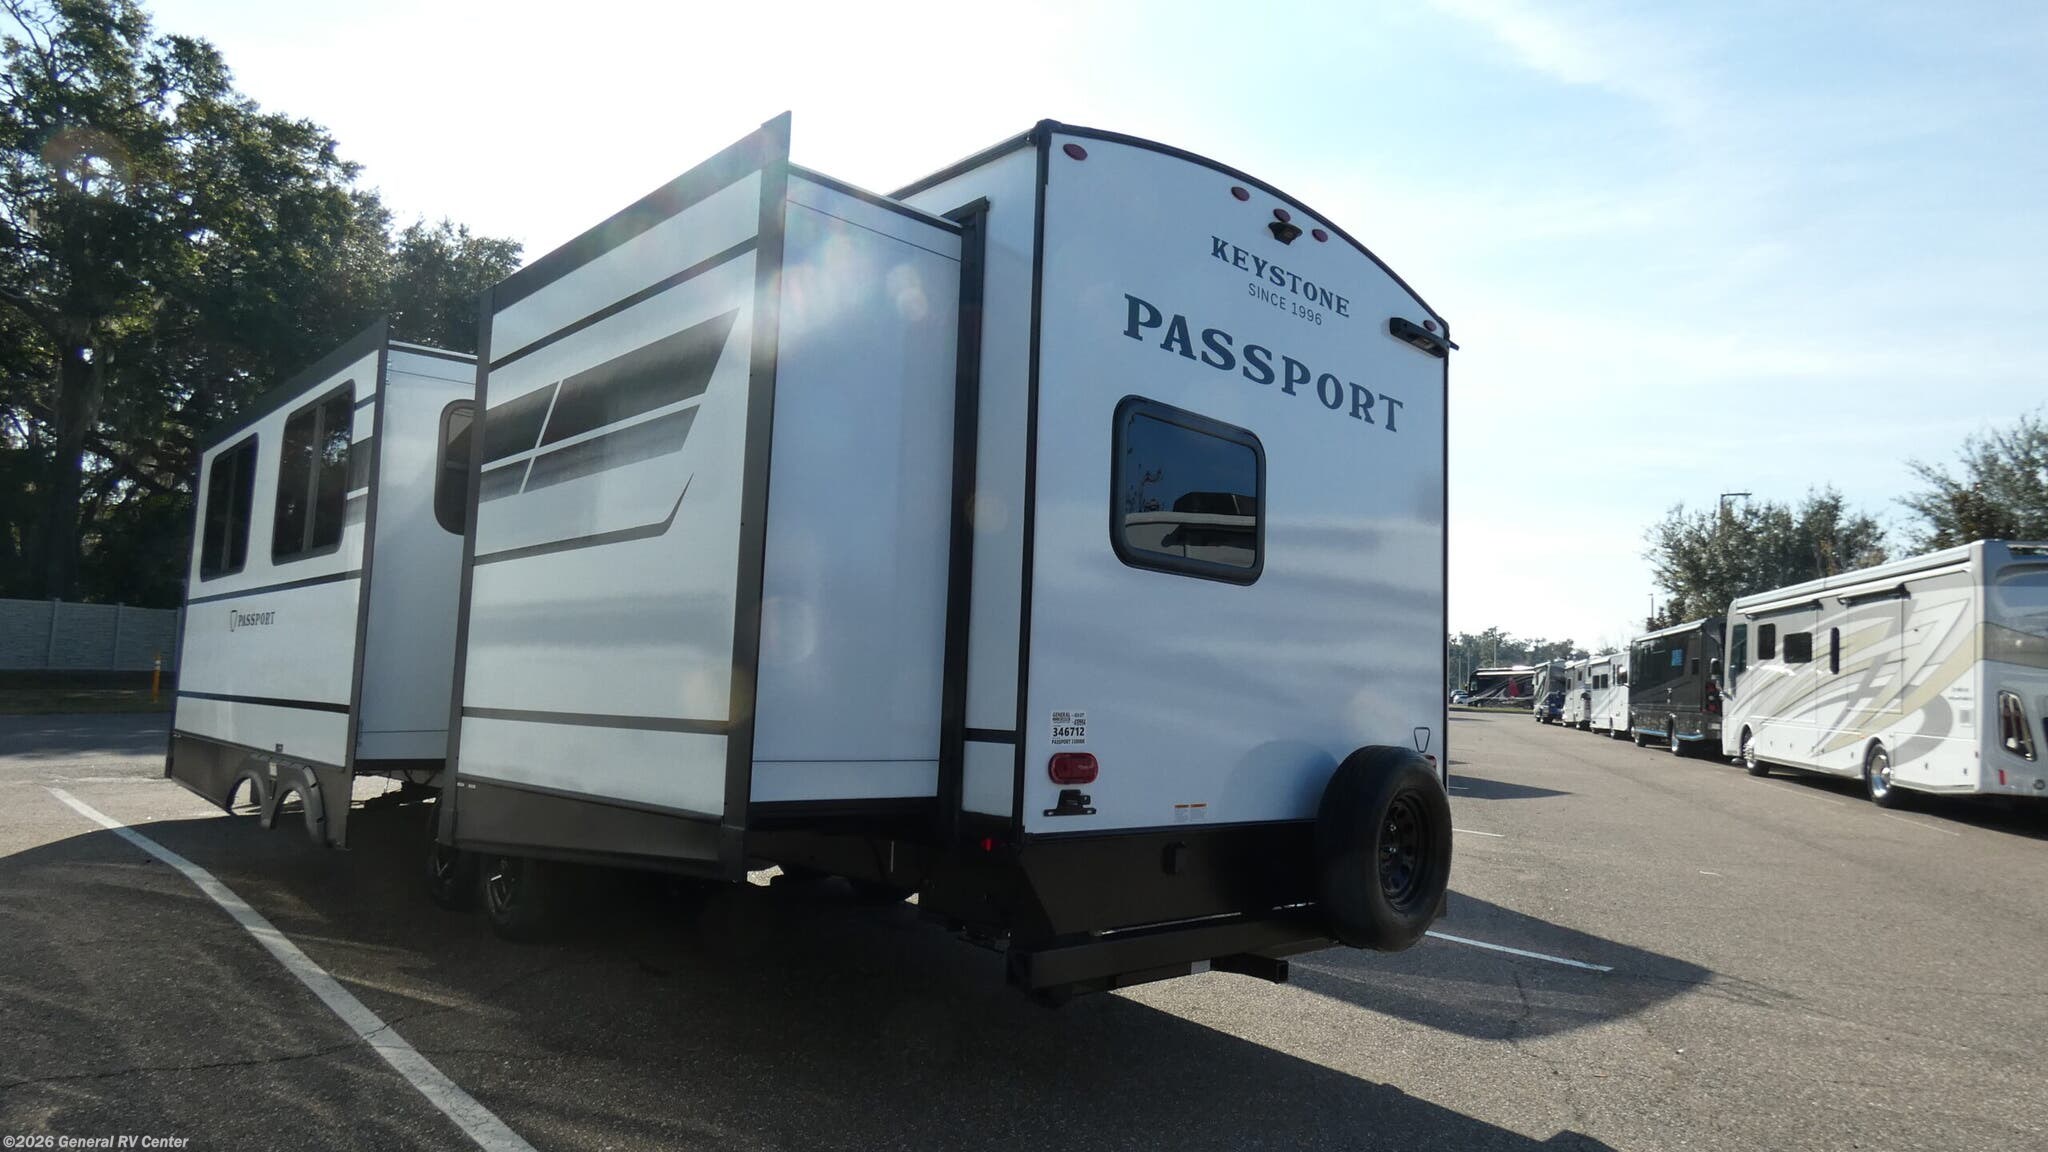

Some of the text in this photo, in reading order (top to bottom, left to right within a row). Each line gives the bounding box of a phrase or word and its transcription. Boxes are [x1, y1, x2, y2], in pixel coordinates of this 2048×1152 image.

[1211, 236, 1350, 318] KEYSTONE
[1248, 282, 1323, 326] SINCE 1996
[1123, 292, 1404, 433] PASSPORT
[238, 611, 276, 627] PASSPORT
[1053, 727, 1085, 737] 346712
